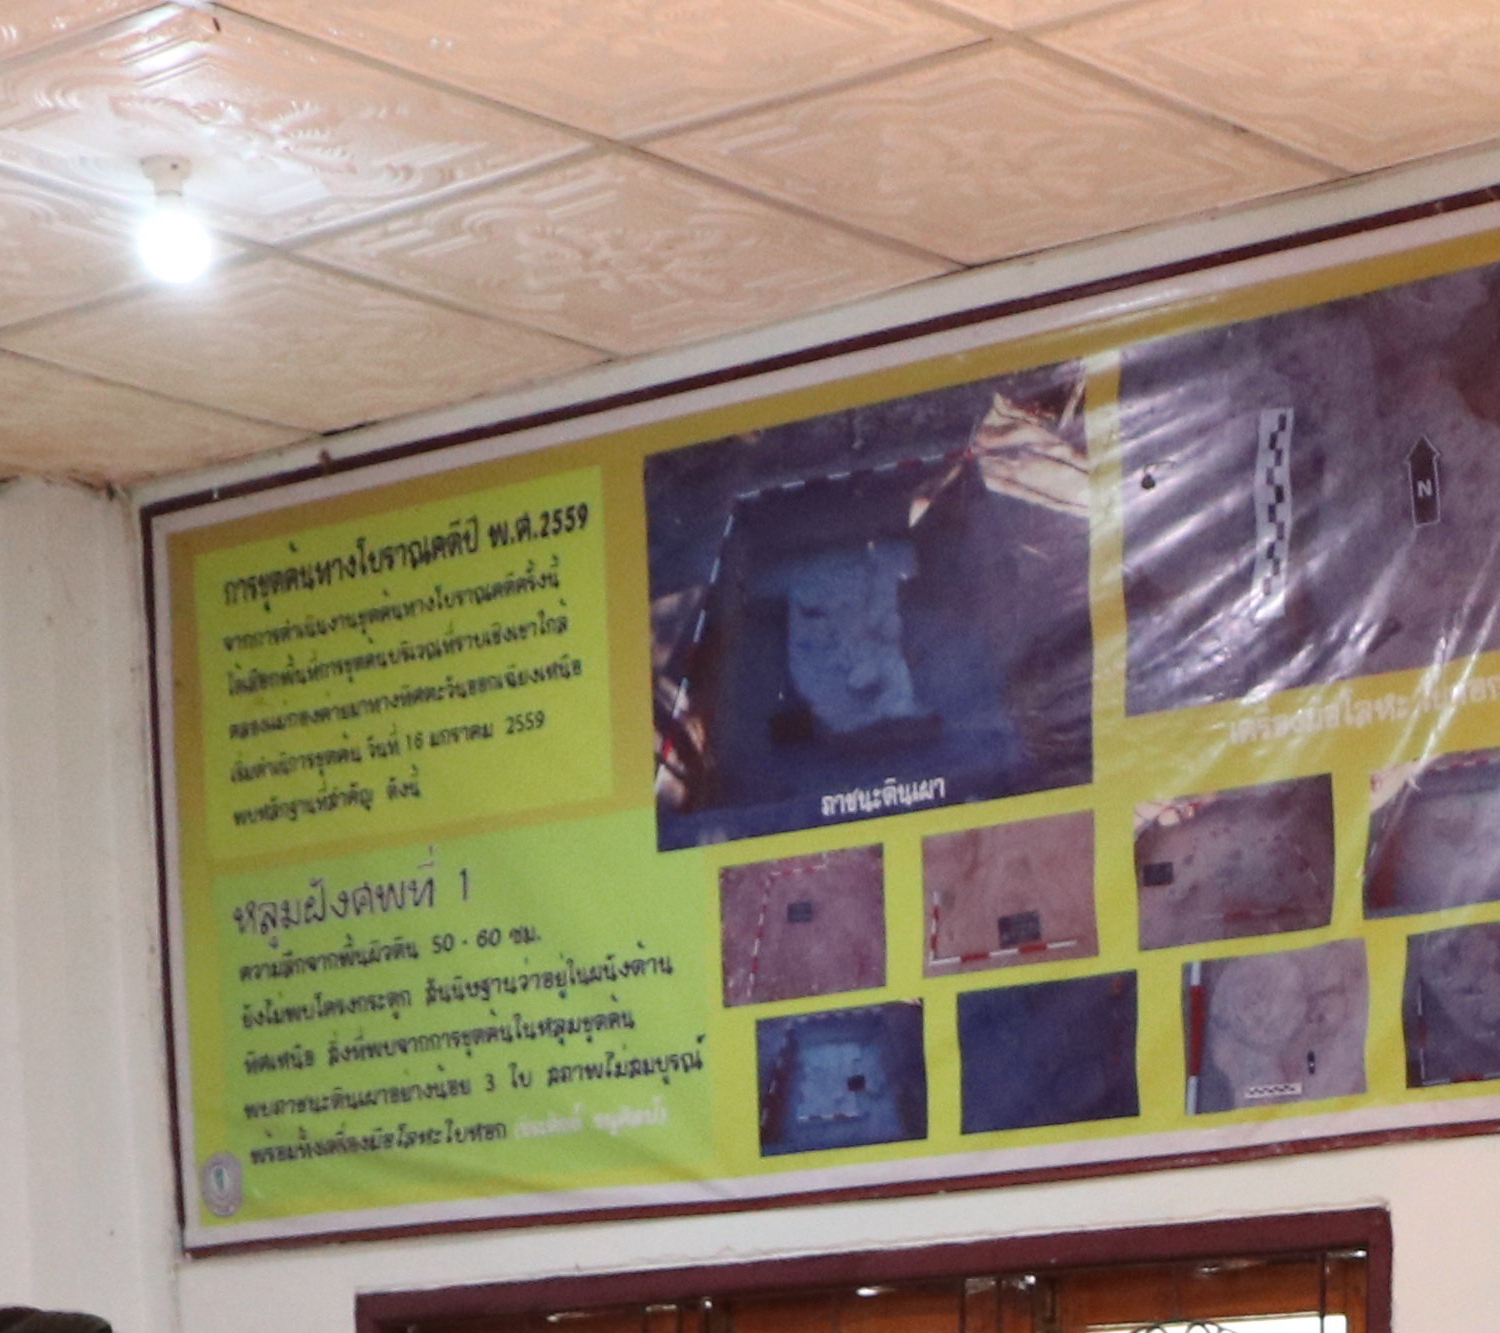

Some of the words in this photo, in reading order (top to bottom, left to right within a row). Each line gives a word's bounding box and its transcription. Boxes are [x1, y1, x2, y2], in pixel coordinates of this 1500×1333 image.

[1416, 478, 1434, 499] N
[486, 501, 588, 549] พ.ศ.2559
[405, 730, 424, 751] 16
[505, 709, 545, 735] 2559
[821, 776, 947, 816] ภาชนะดินเผา
[458, 867, 468, 901] 1
